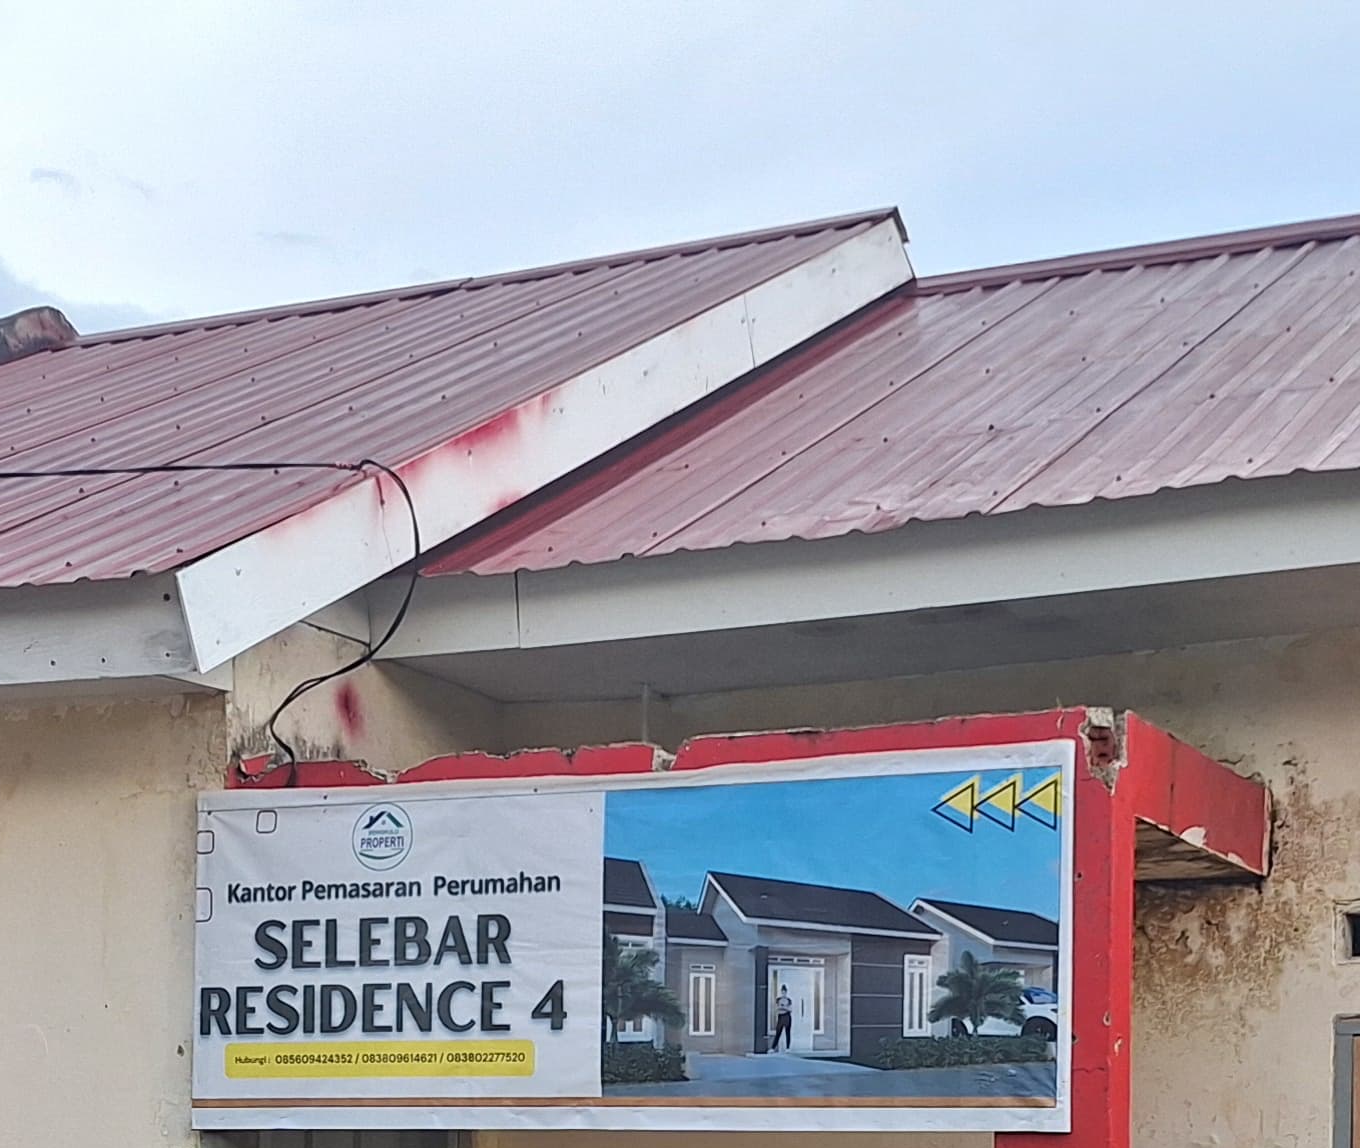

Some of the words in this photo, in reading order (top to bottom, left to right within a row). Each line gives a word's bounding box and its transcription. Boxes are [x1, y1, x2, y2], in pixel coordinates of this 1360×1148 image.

[360, 836, 405, 849] PROPERTI
[227, 882, 296, 904] Kantor
[302, 878, 422, 901] Pemasaran
[433, 872, 561, 896] Perumahan
[253, 914, 512, 970] SELEBAR
[199, 980, 512, 1036] RESIDENCE
[530, 979, 568, 1031] 4
[275, 1053, 353, 1065] 085609424352
[446, 1051, 526, 1063] 083802277520
